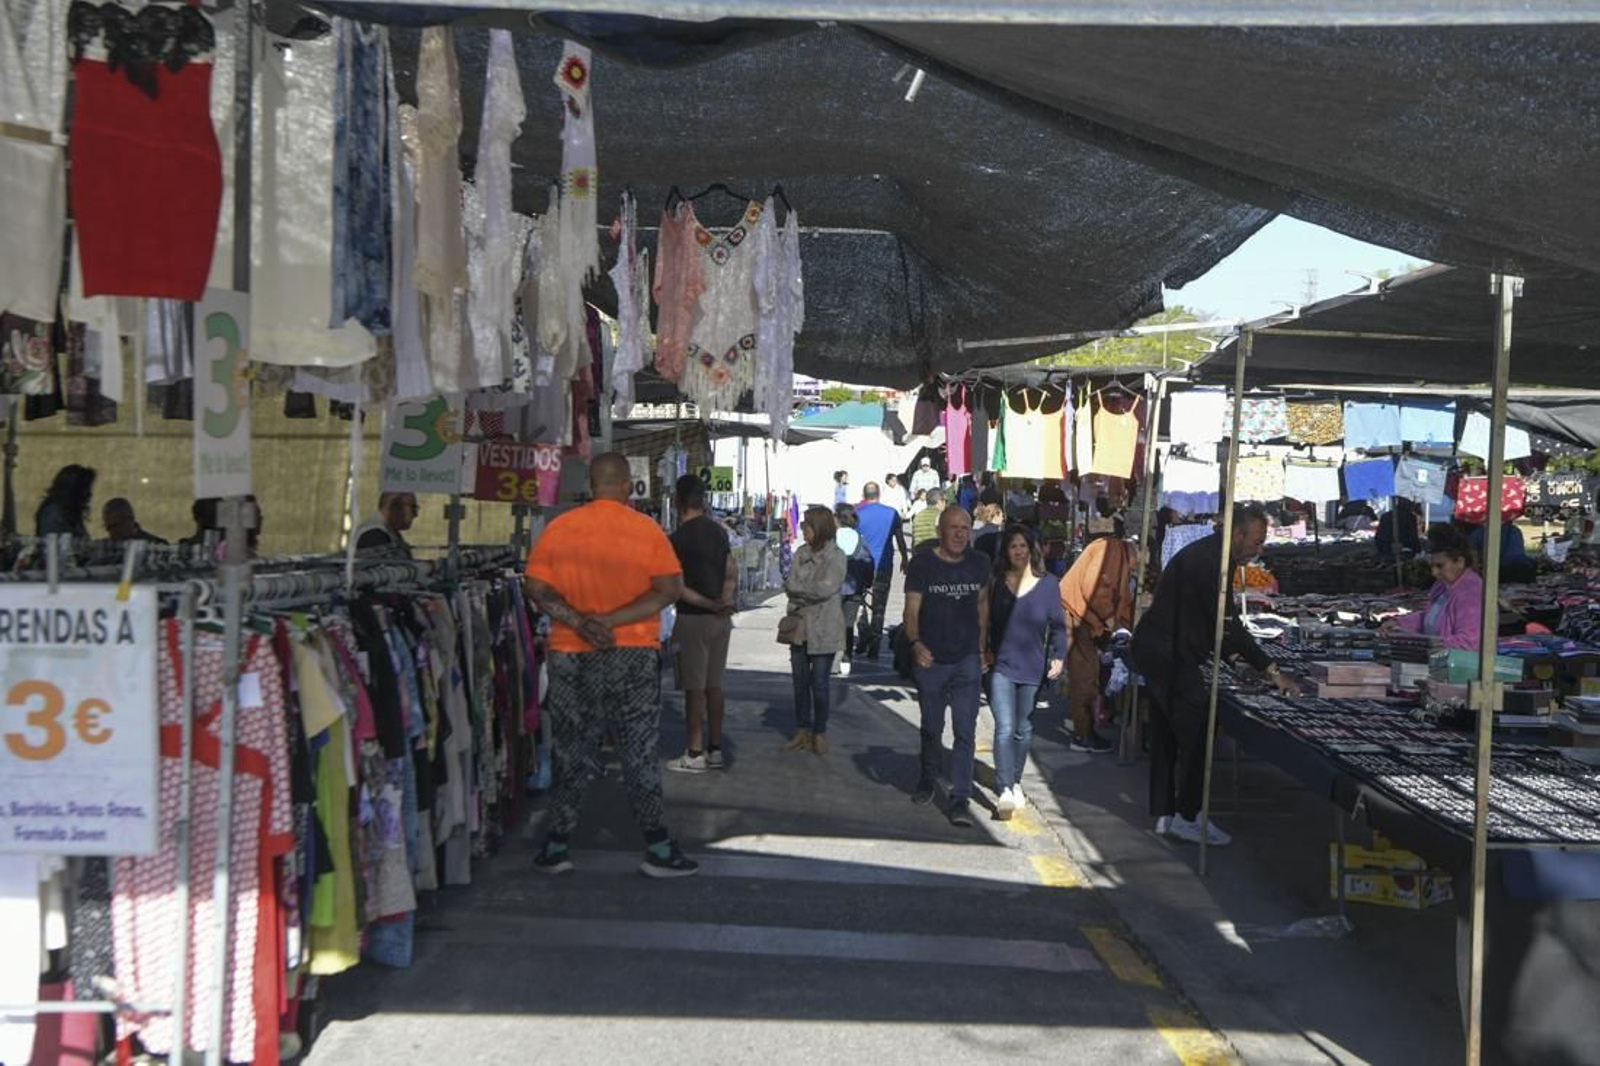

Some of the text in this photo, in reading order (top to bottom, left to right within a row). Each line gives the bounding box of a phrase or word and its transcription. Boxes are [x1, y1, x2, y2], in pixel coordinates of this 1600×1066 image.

[479, 443, 561, 472] VESTIDOS
[497, 471, 541, 501] 3€
[116, 609, 136, 645] A
[4, 679, 114, 762] 3€
